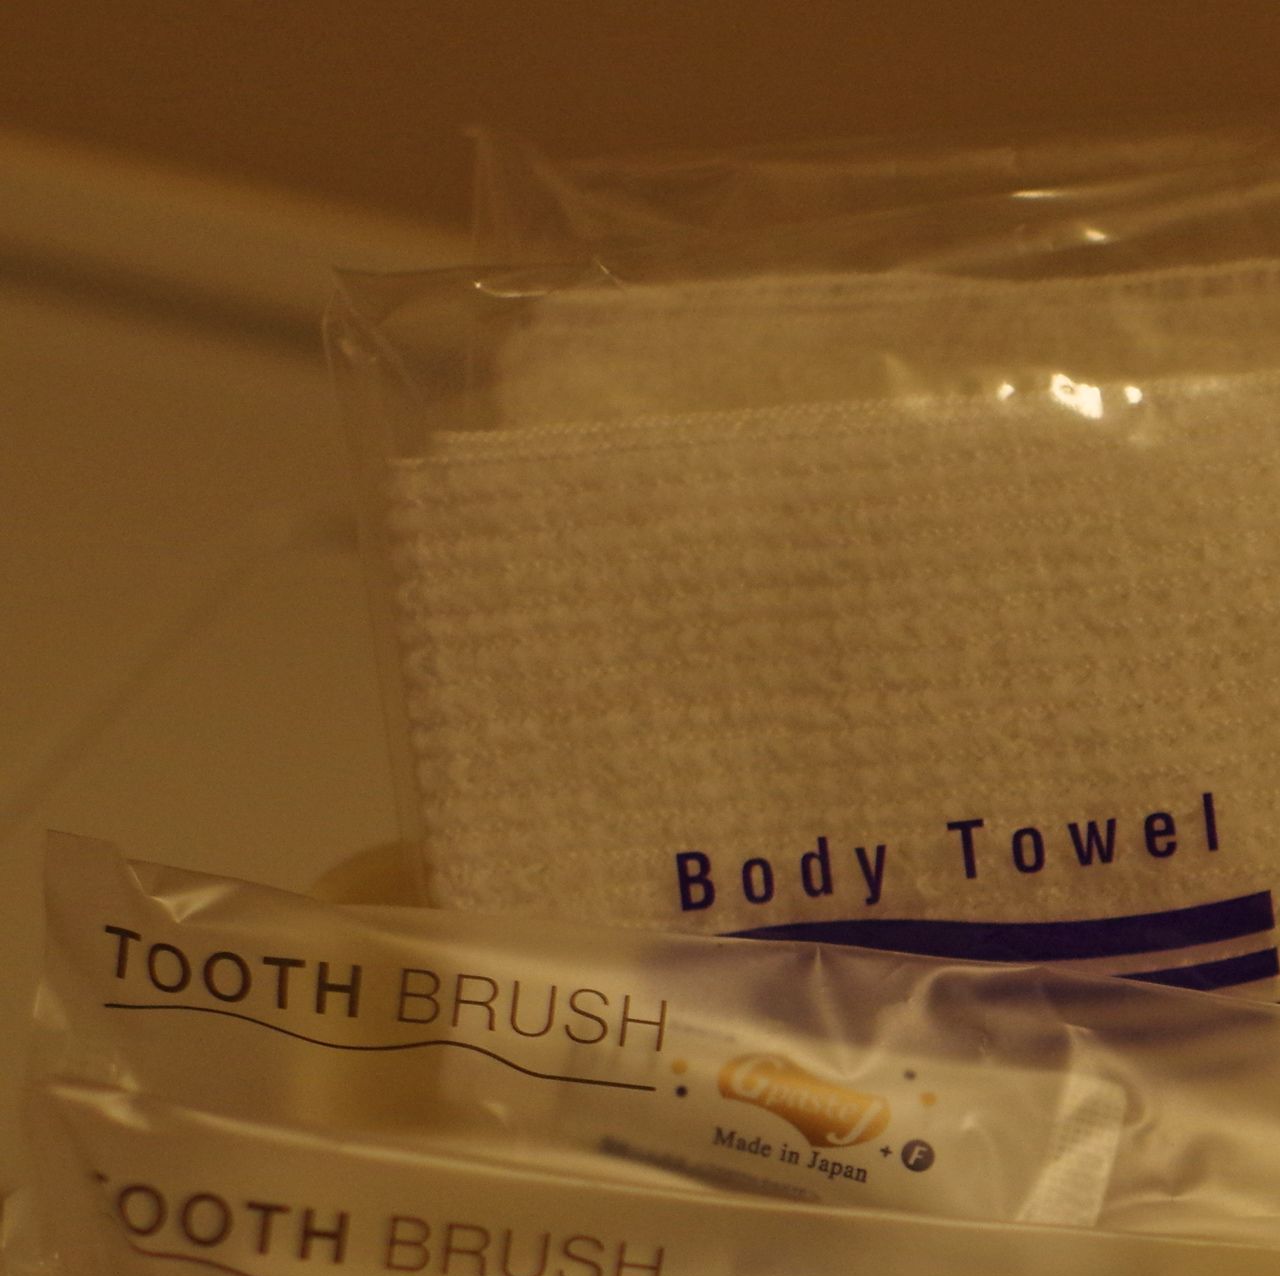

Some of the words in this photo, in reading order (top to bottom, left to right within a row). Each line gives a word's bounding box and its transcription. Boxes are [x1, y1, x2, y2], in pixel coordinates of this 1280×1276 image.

[675, 837, 888, 912] Body
[946, 792, 1219, 880] Towel
[104, 925, 363, 1019] TOOTH
[395, 967, 668, 1052] BRUSH
[711, 1127, 773, 1158] Made
[780, 1143, 800, 1166] in
[806, 1150, 869, 1184] Japan
[92, 1170, 350, 1265] OOTH
